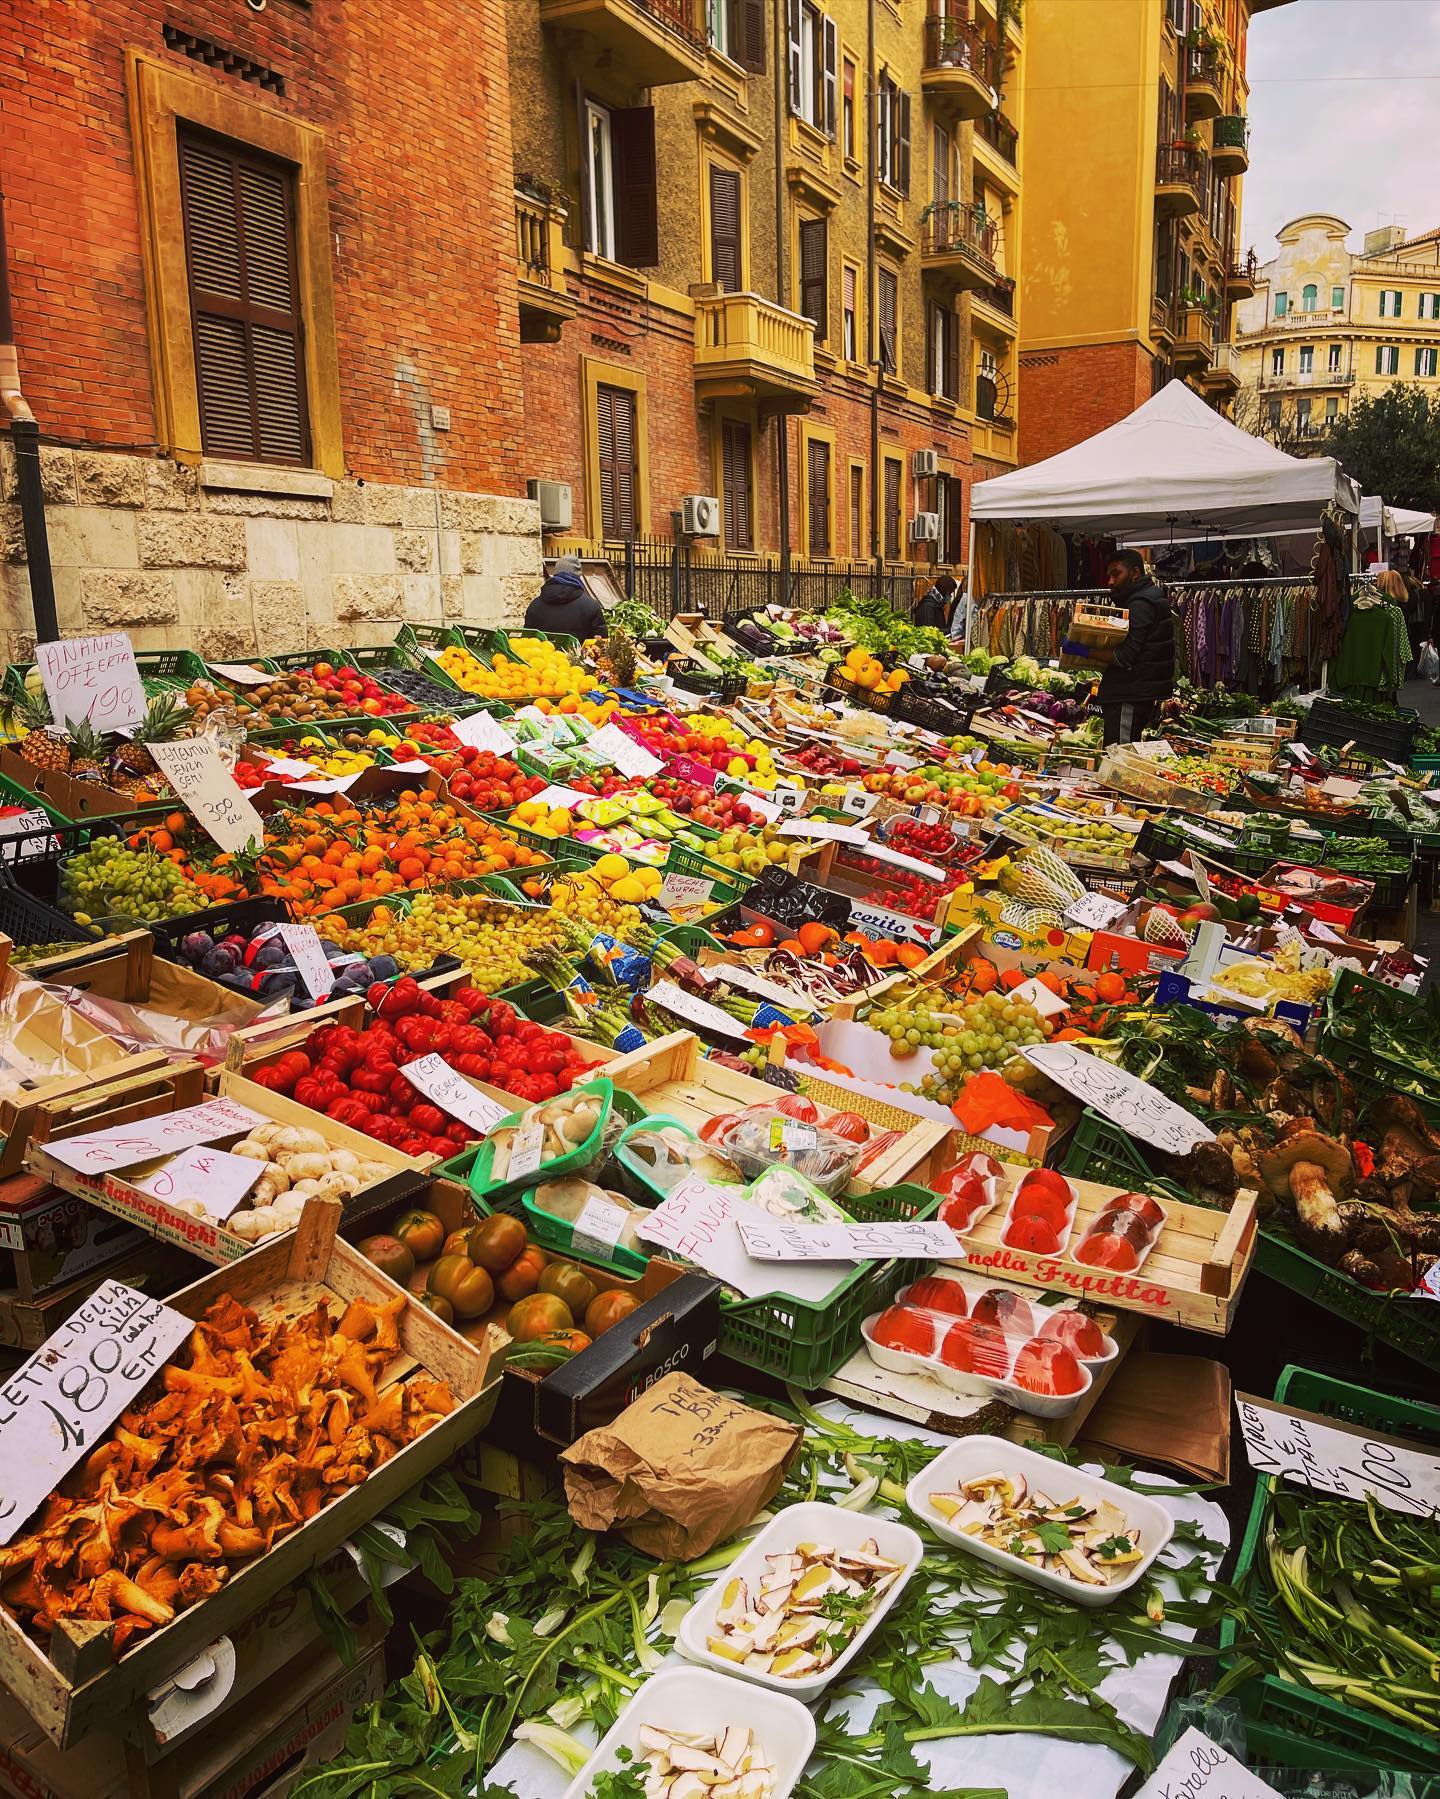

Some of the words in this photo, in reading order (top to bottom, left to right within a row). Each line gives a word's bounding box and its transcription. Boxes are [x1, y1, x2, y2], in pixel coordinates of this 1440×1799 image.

[44, 635, 124, 677] ANANAS
[56, 652, 130, 690] OFFERTA
[406, 1056, 442, 1082] VERO
[642, 1184, 706, 1240] MISTO
[1032, 1258, 1172, 1307] Frutta
[99, 1296, 143, 1335] SILA
[645, 1343, 690, 1390] BOSCO
[1289, 1418, 1331, 1487] ITALIA
